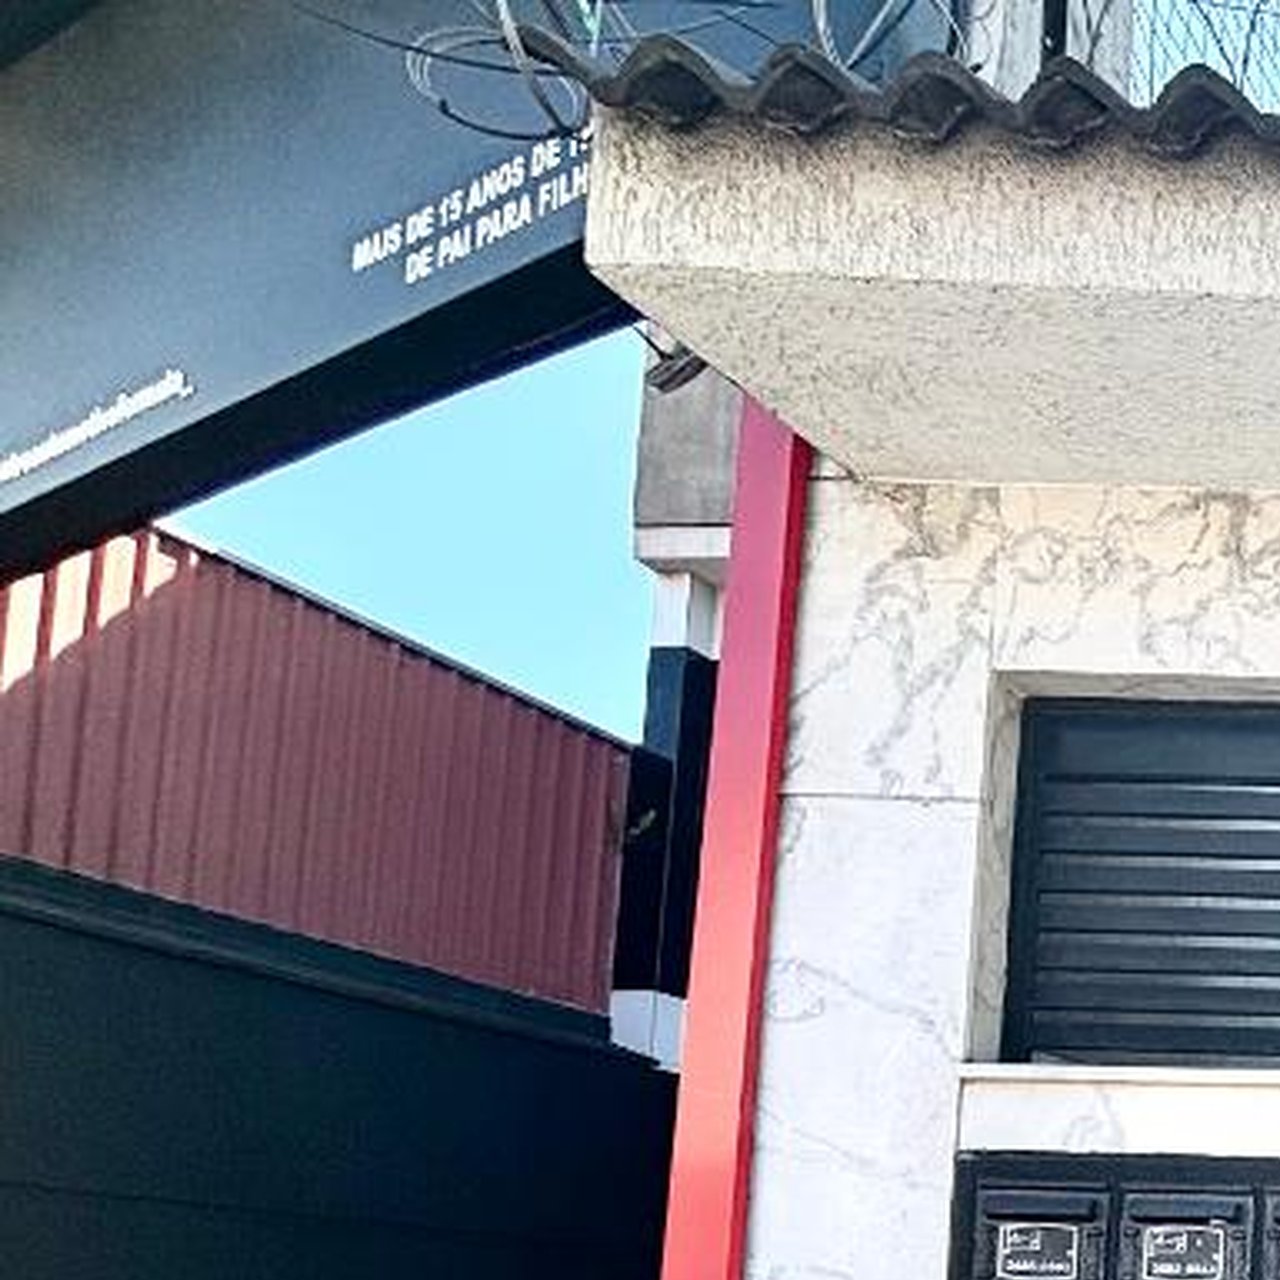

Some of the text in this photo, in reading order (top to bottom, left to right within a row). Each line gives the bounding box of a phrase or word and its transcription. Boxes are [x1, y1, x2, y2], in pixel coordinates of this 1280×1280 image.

[352, 222, 403, 272] MAIS
[405, 206, 435, 245] DE
[438, 188, 465, 228] 15
[466, 154, 526, 215] ANOS
[531, 137, 562, 178] DE
[404, 161, 589, 285] DE PAI PARA FILH
